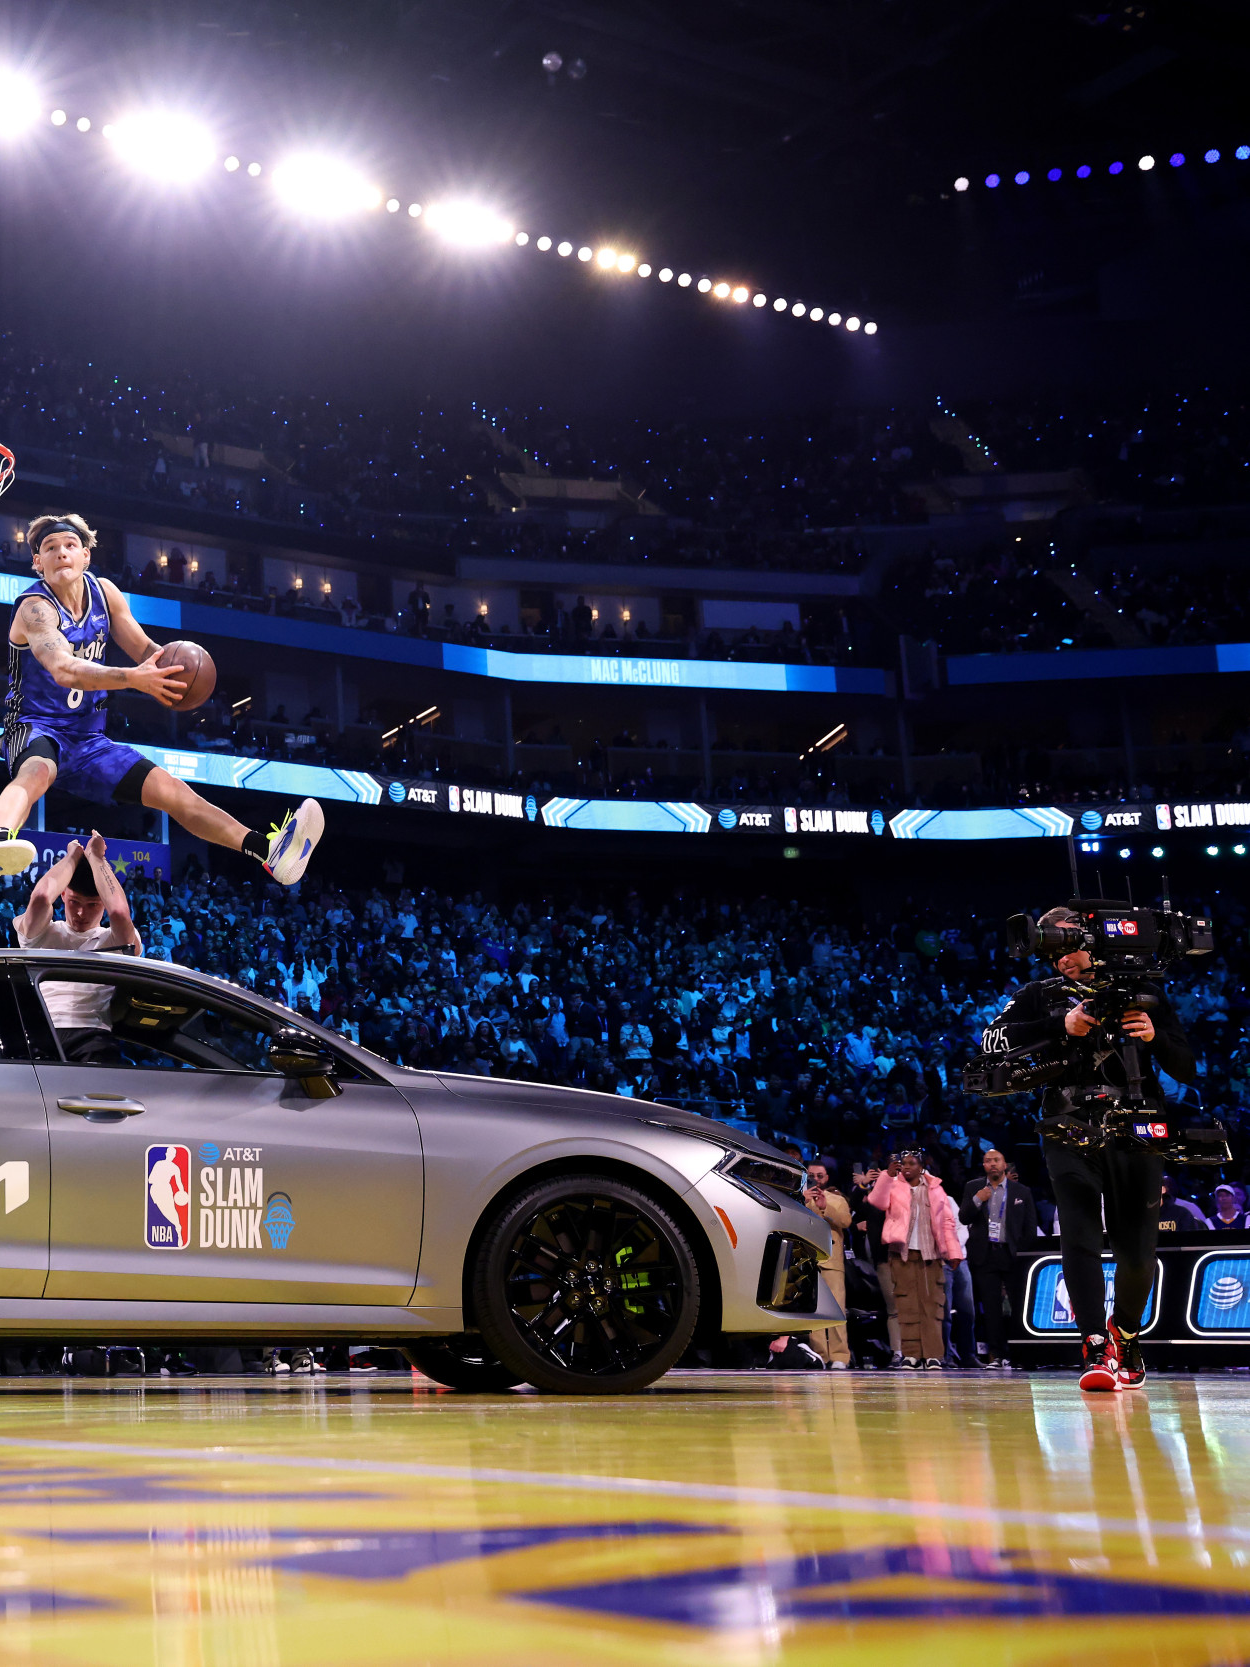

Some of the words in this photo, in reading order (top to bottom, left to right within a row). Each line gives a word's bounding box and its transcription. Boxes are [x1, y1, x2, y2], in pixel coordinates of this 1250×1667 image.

[590, 659, 619, 682] MAC
[621, 660, 680, 684] McCLUNG
[407, 788, 438, 804] AT&T
[462, 789, 493, 815] SLAM
[494, 793, 524, 818] DUNK
[739, 813, 772, 827] AT&T
[800, 809, 834, 832] SLAM
[836, 811, 869, 834] DUNK
[1104, 812, 1142, 827] AT&T
[1174, 804, 1214, 828] SLAM
[132, 851, 151, 862] 104
[1106, 922, 1118, 933] NBA
[223, 1147, 263, 1161] AT&T
[200, 1166, 264, 1208] SLAM
[151, 1225, 173, 1243] NBA
[200, 1208, 263, 1249] DUNK
